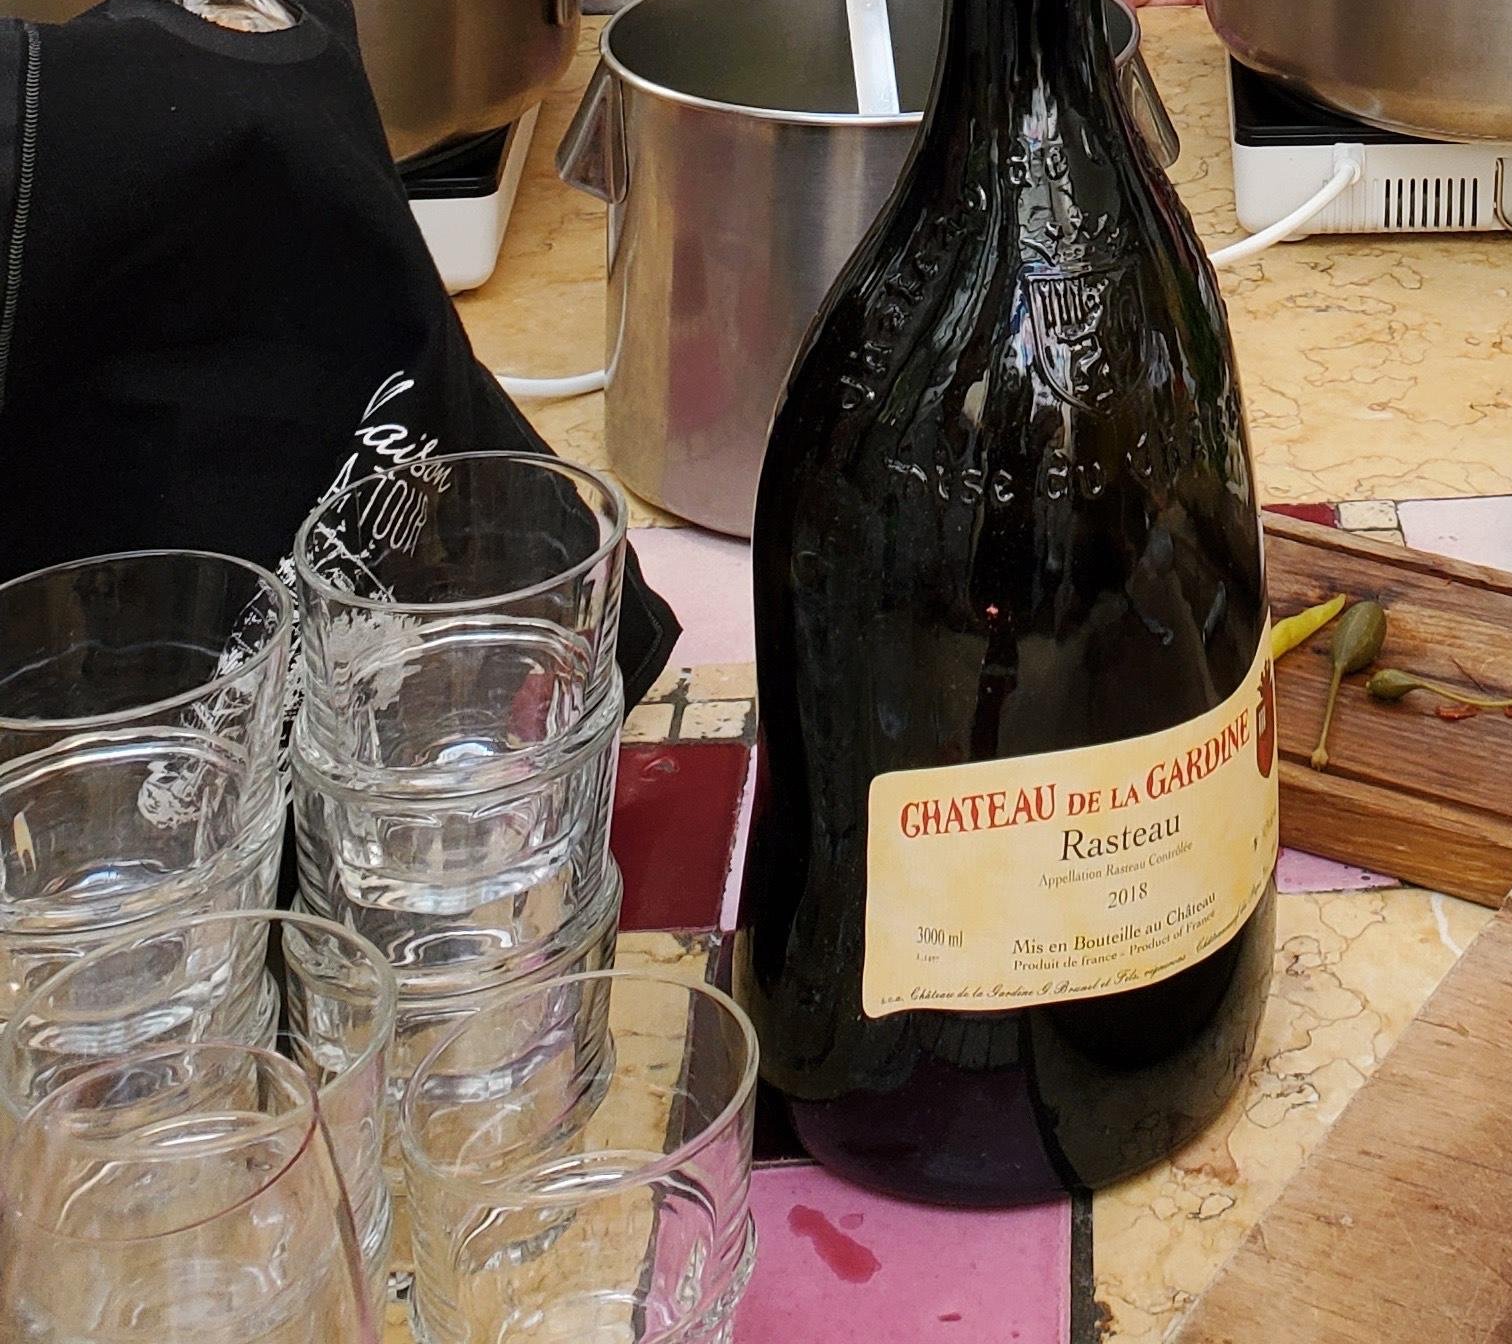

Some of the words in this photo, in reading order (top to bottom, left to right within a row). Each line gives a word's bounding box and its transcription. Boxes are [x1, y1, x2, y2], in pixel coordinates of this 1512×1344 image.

[900, 783, 1058, 839] CHATEAU
[1067, 791, 1102, 817] DE
[1110, 782, 1142, 810] LA
[1145, 708, 1251, 800] GARDINE
[1058, 813, 1181, 861] Rasteau
[1038, 870, 1103, 890] Appellation
[1106, 860, 1146, 877] Rasteau
[1149, 840, 1194, 867] Contrôlée
[1108, 882, 1149, 910] 2018
[916, 926, 945, 945] 3000
[948, 930, 963, 949] ml
[1012, 939, 1044, 955] Mis
[1049, 941, 1068, 954] en
[1074, 924, 1142, 951] Bouteille
[1145, 920, 1162, 935] au
[1166, 892, 1217, 927] Château
[1013, 959, 1060, 972] Produit
[1063, 955, 1078, 968] de
[1129, 934, 1171, 957] Product
[1172, 928, 1184, 941] of
